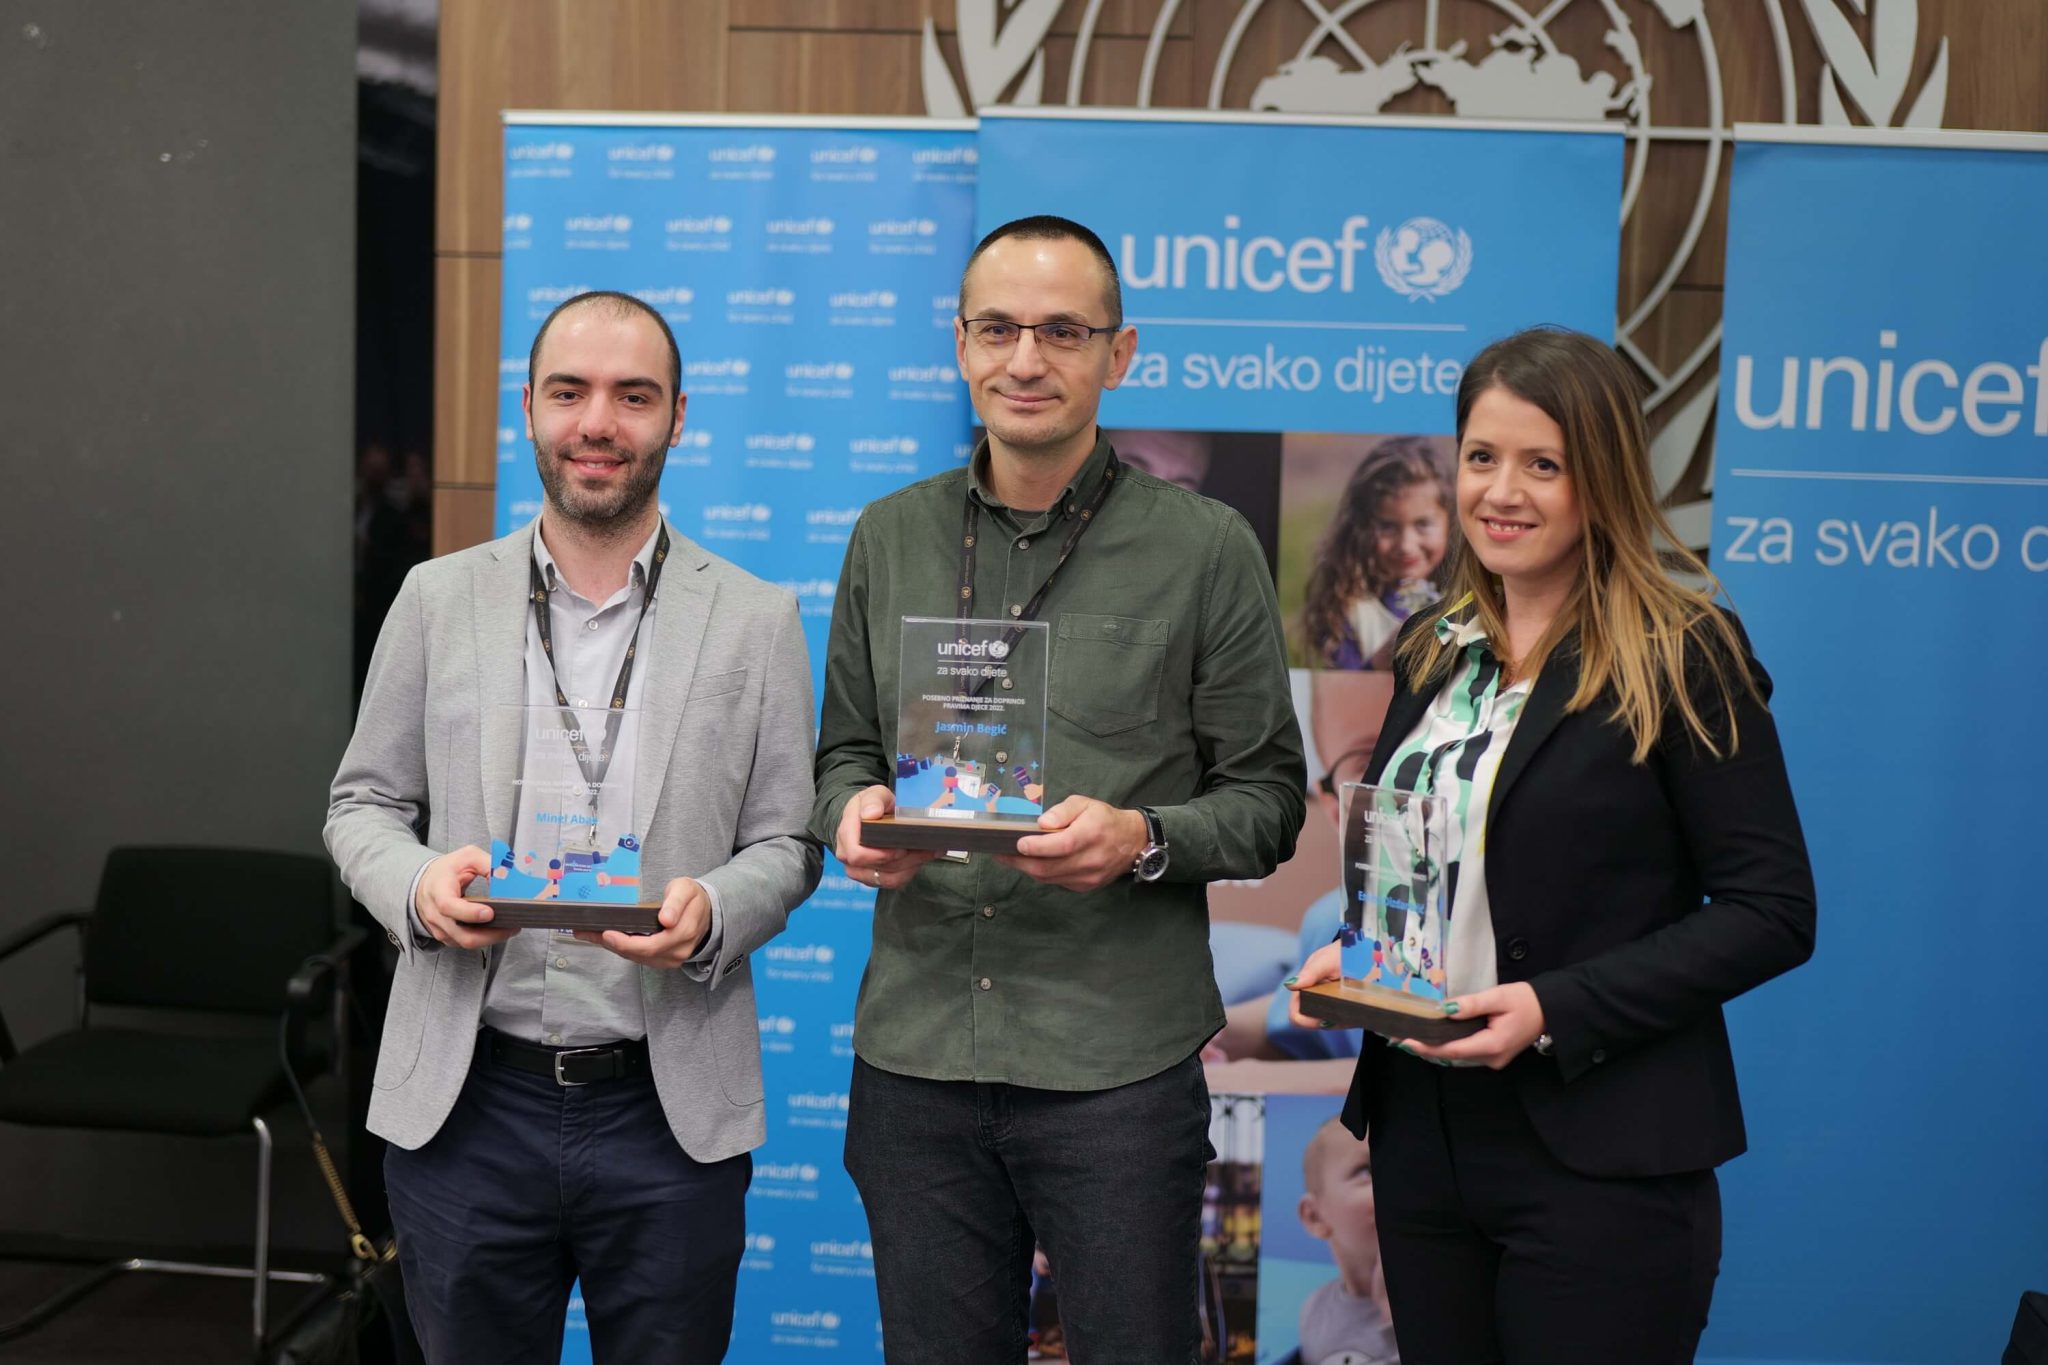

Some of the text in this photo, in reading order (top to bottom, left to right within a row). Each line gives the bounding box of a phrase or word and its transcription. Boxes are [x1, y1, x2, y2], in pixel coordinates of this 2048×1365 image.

[1120, 214, 1369, 293] unicef
[1121, 343, 1463, 404] za svako dijete
[1734, 329, 2048, 437] unicef
[1724, 516, 1794, 564] za
[1815, 505, 2001, 571] svako
[937, 639, 988, 656] unicef
[937, 666, 1008, 679] za svako dijete
[935, 721, 1008, 736] Jasmin Begić
